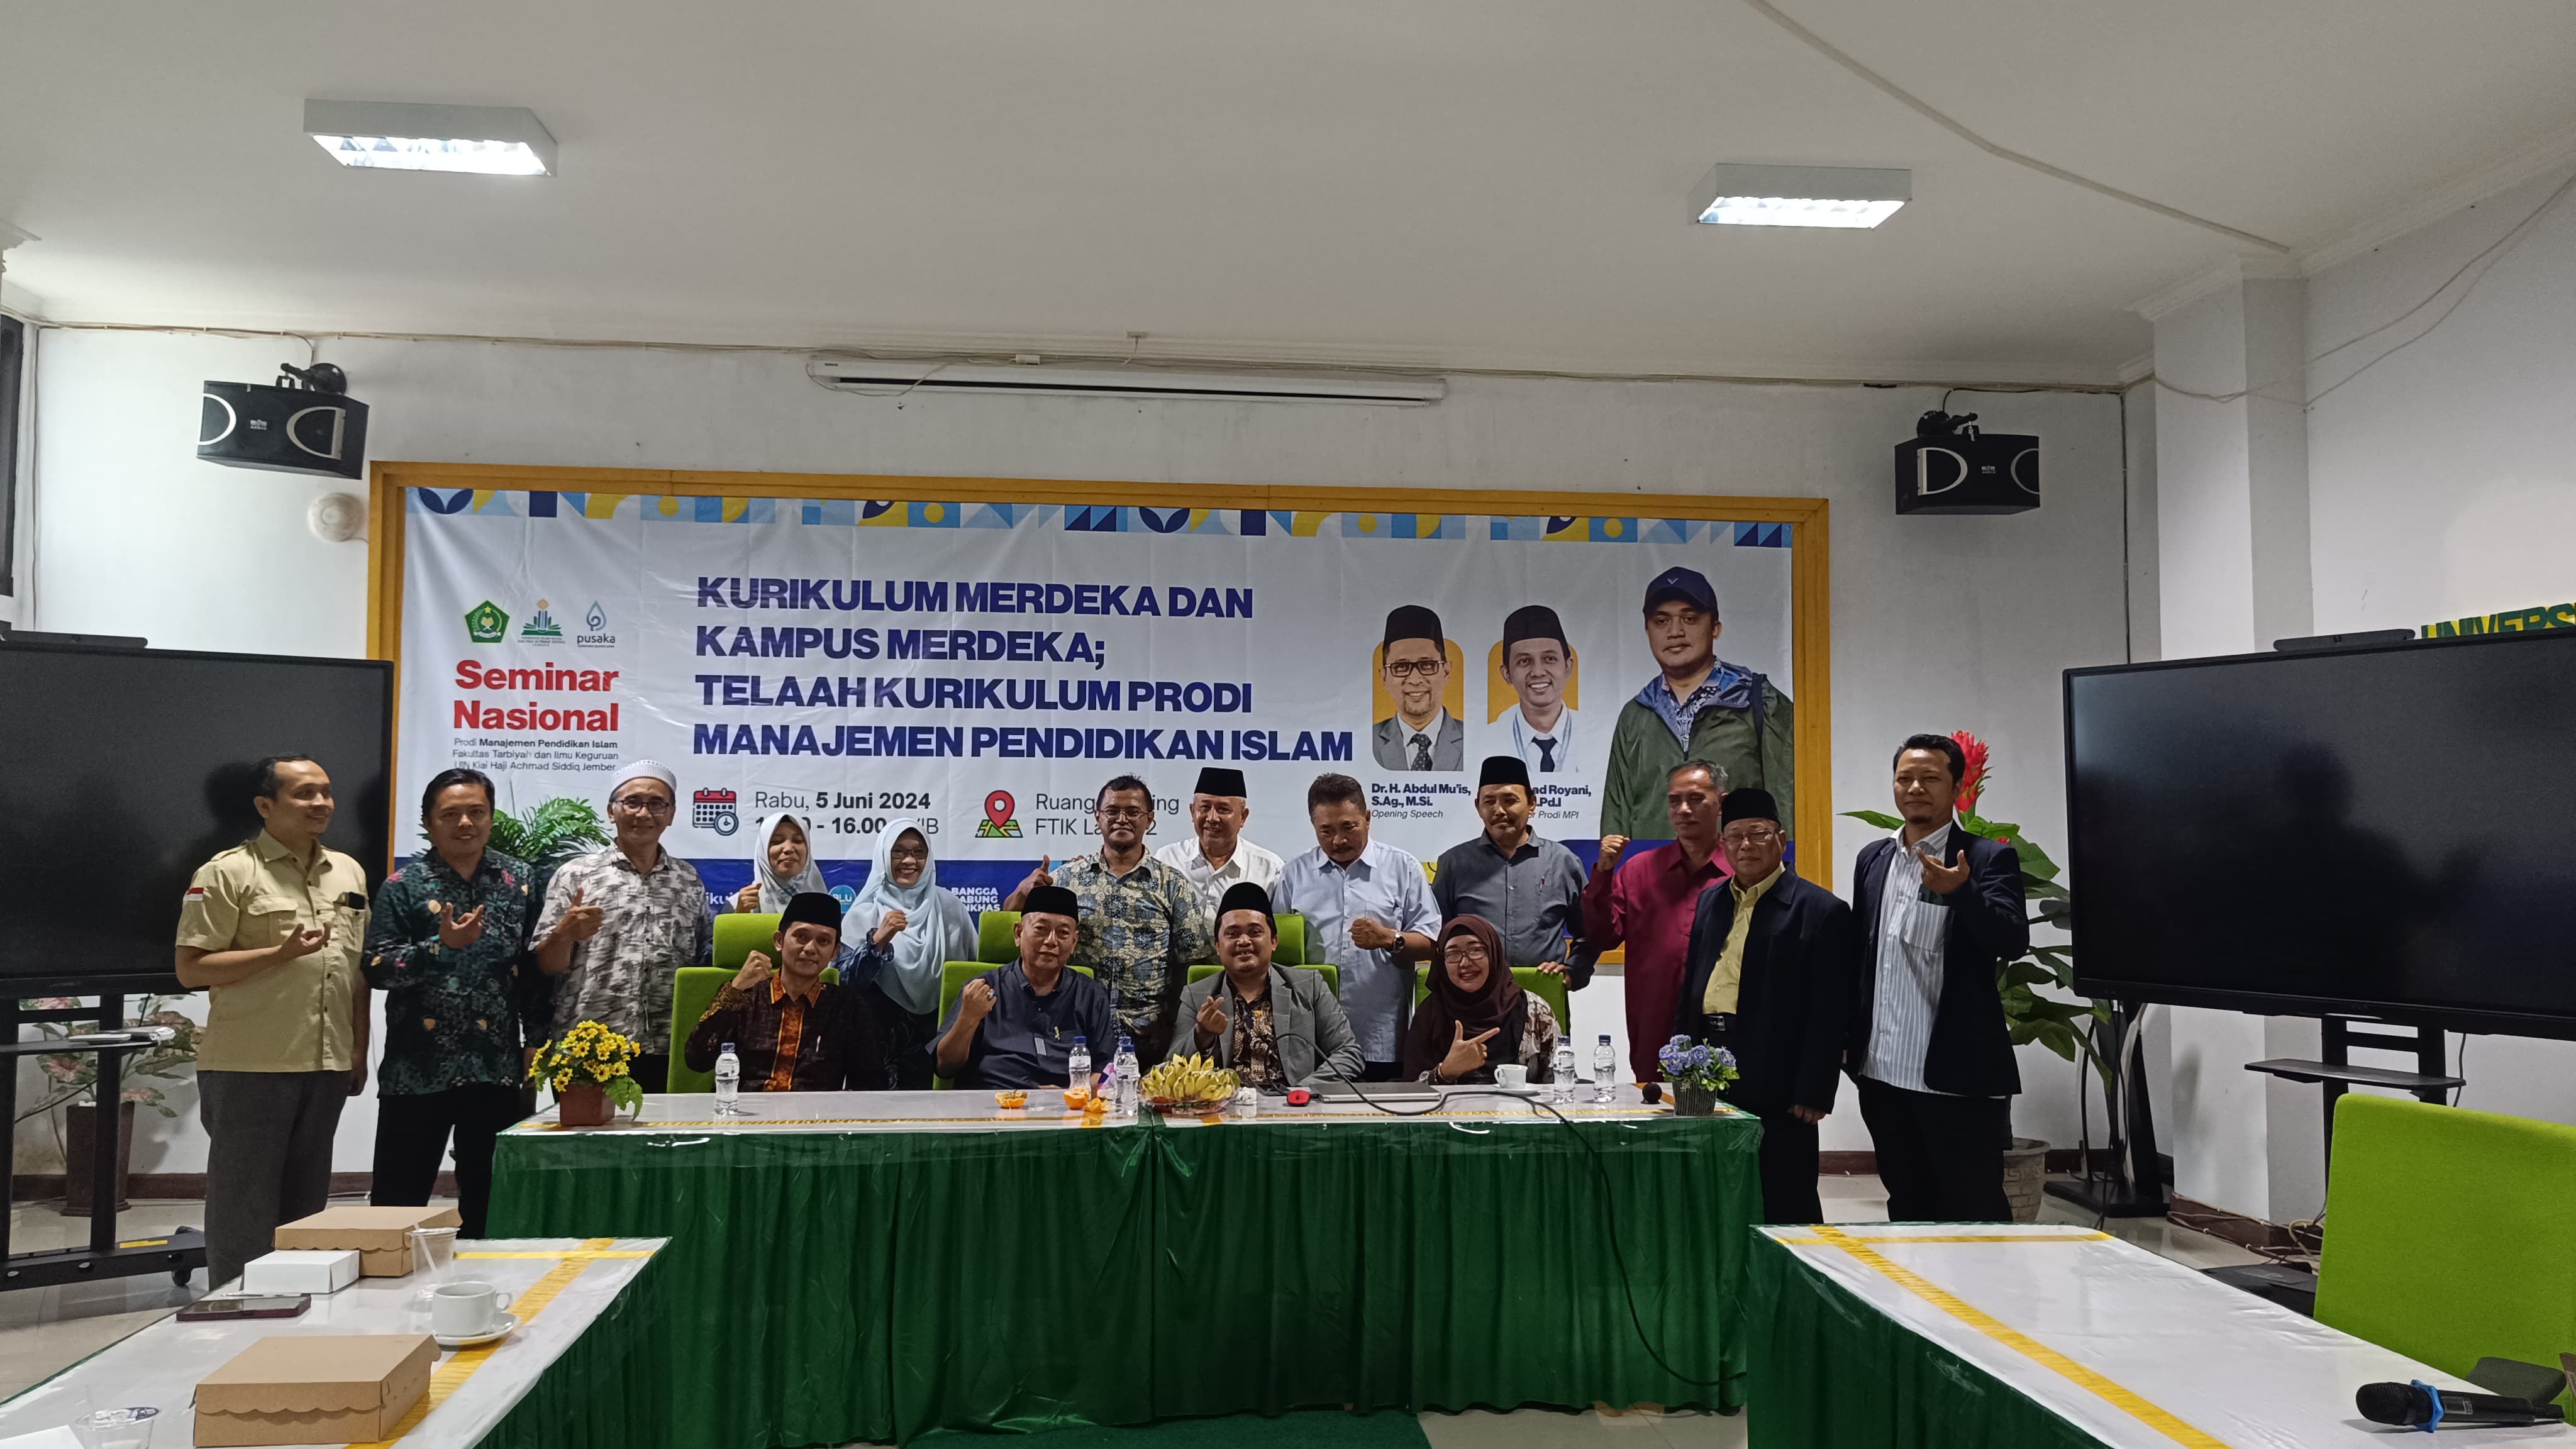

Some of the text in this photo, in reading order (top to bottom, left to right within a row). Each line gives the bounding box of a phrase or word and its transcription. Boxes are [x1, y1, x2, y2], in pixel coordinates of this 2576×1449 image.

[697, 577, 1252, 618] KURIKULUM MERDEKA DAN
[2421, 602, 2576, 639] UNIVERS
[577, 633, 616, 644] pusaka
[696, 626, 1104, 670] KAMPUS MERDEKA;
[455, 659, 619, 692] Seminar
[695, 675, 1252, 713] TELAAH KURIKULUM PRODI
[453, 699, 619, 731] Nasional
[454, 738, 618, 748] Prodi Manajemen Pendidikan Islam
[694, 724, 1352, 761] MANAJEMEN PENDIDIKAN ISLAM
[452, 749, 619, 762] Fakultas Tarbiyah dan Ilmu Keguruan
[472, 761, 488, 770] Kiai
[491, 761, 508, 772] Haji
[509, 762, 549, 770] Achmad
[552, 762, 580, 772] Siddiq
[582, 763, 616, 771] Jember
[1371, 783, 1471, 796] Dr. H. Abdul Mu'is,
[1532, 784, 1592, 797] ad Royani,
[755, 791, 931, 812] Rabu, 5 Juni 2024
[1036, 793, 1179, 815] Ruang ing
[1371, 796, 1433, 808] S.Ag., M.Si.
[1536, 797, 1562, 808] .Pd.I
[1371, 809, 1443, 819] Opening Speech
[1538, 811, 1561, 819] Prodi
[1562, 811, 1579, 819] MPI
[831, 817, 887, 834] 16.00
[917, 818, 939, 835] IB
[1036, 818, 1157, 835] FTIK La 2
[951, 887, 999, 896] BANGGA
[960, 896, 999, 904] ABUNG
